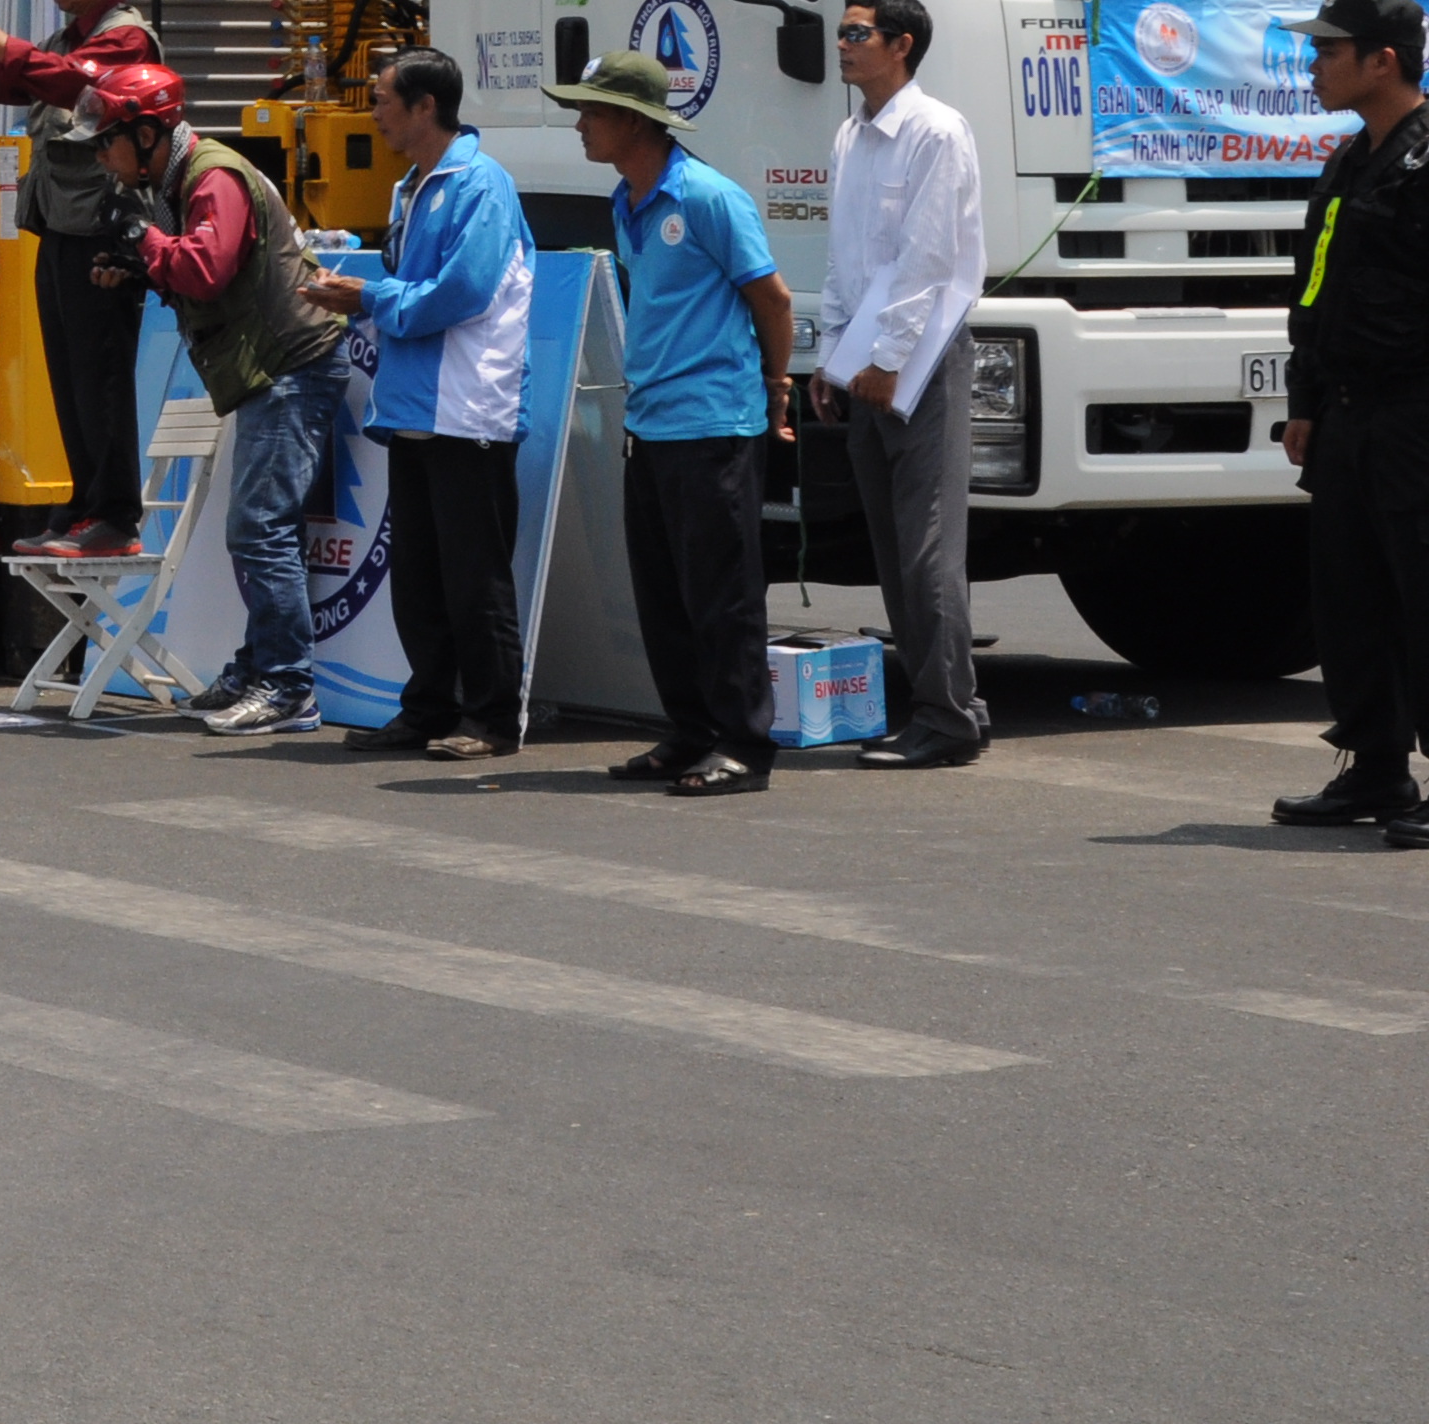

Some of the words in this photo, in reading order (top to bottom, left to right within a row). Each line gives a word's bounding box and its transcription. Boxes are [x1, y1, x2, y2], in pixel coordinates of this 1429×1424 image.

[1022, 46, 1083, 117] CÔNG
[1097, 76, 1131, 116] GIẢI
[1170, 86, 1192, 114] XE
[1195, 87, 1225, 121] ĐẠP
[1230, 80, 1252, 116] NỮ
[1256, 76, 1296, 117] QUỐC
[1131, 133, 1180, 162] TRANH
[1186, 126, 1217, 162] CÚP
[766, 169, 828, 184] ISUZU
[308, 537, 354, 566] ASE
[814, 675, 869, 698] BIWASE
